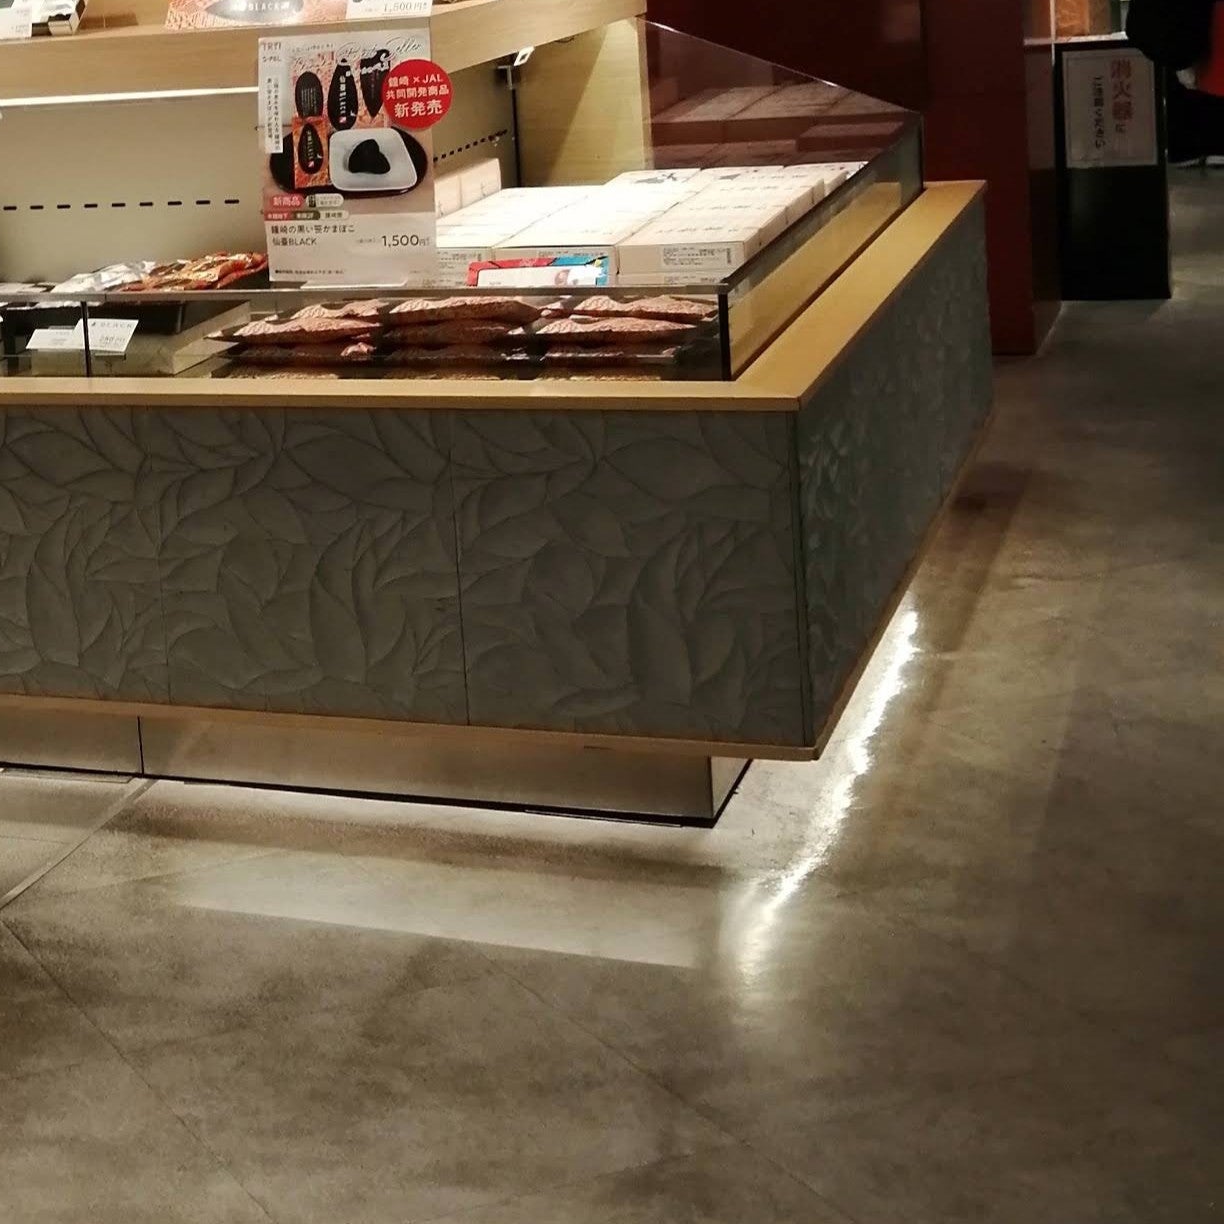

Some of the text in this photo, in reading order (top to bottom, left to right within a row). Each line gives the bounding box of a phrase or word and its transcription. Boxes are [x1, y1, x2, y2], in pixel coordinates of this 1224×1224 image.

[422, 74, 444, 84] JAL
[386, 84, 450, 101] 共同開発商品
[394, 99, 444, 118] 新発売
